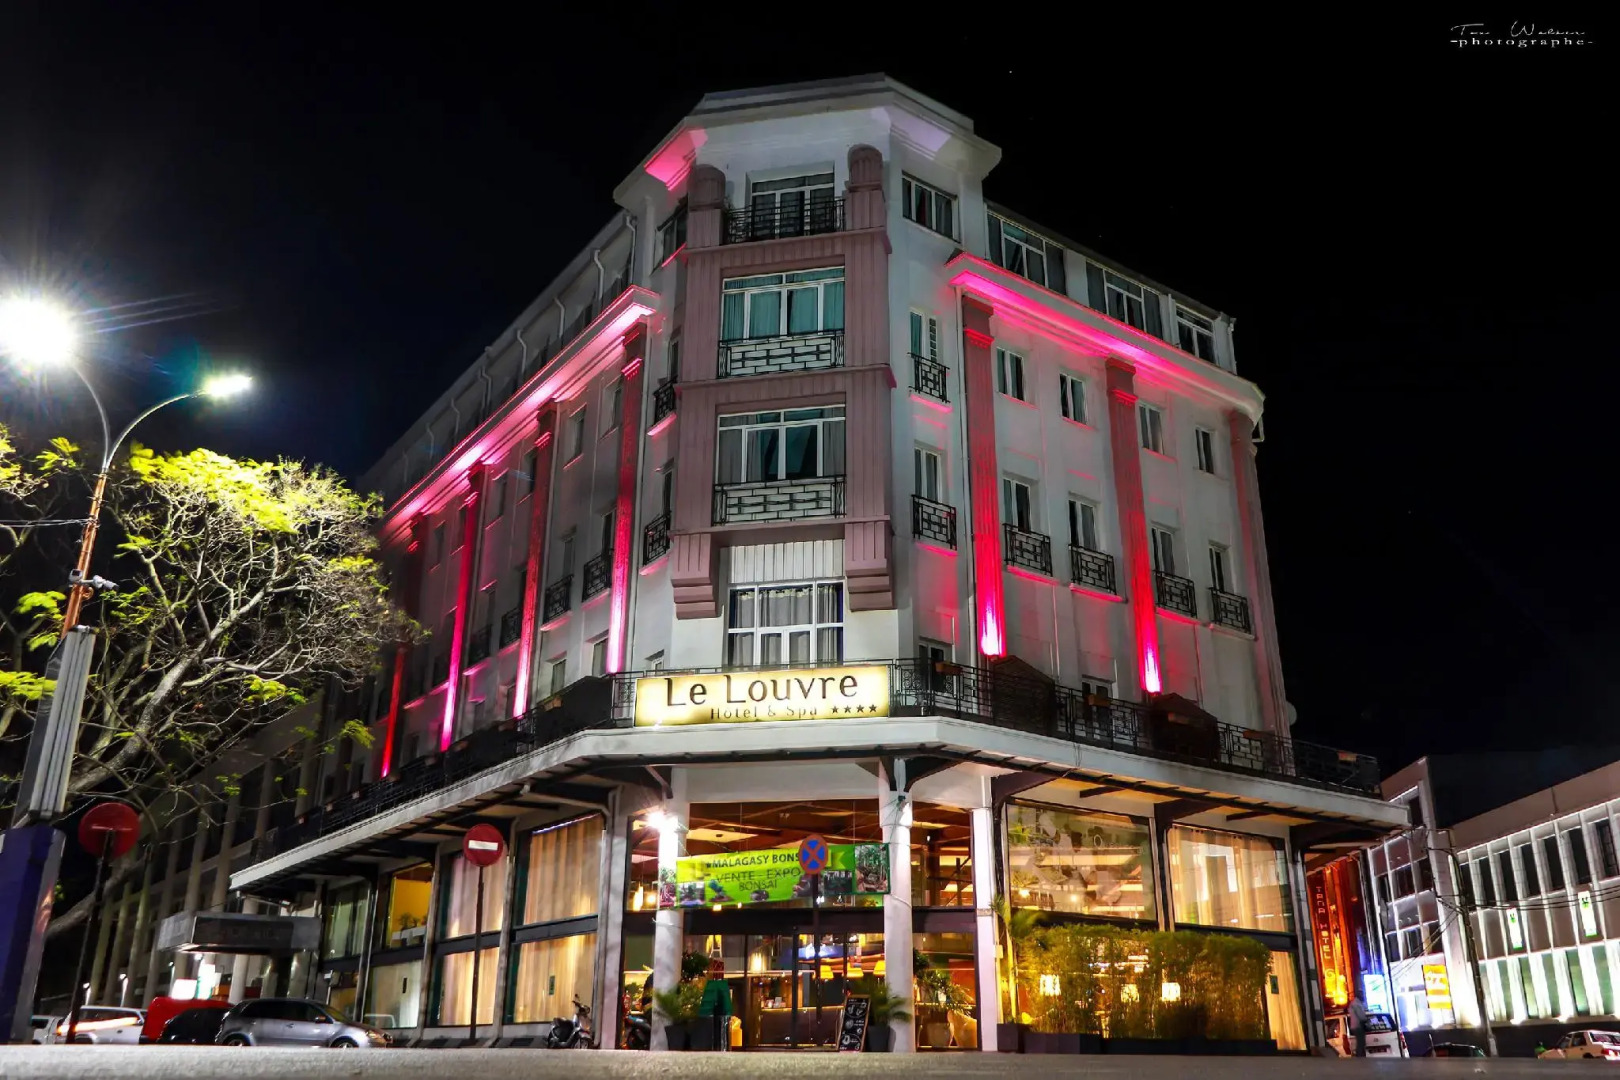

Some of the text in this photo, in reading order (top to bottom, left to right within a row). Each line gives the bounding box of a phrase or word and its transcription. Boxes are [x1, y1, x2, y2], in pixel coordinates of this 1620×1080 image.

[664, 674, 858, 707] Le Louvre
[767, 704, 776, 717] &
[786, 704, 818, 719] Spa
[712, 852, 799, 868] MALAGASY BONS
[716, 870, 755, 883] VENTE
[767, 866, 801, 880] EXPO
[739, 879, 778, 892] BONSAI
[1320, 923, 1331, 960] HOTEL
